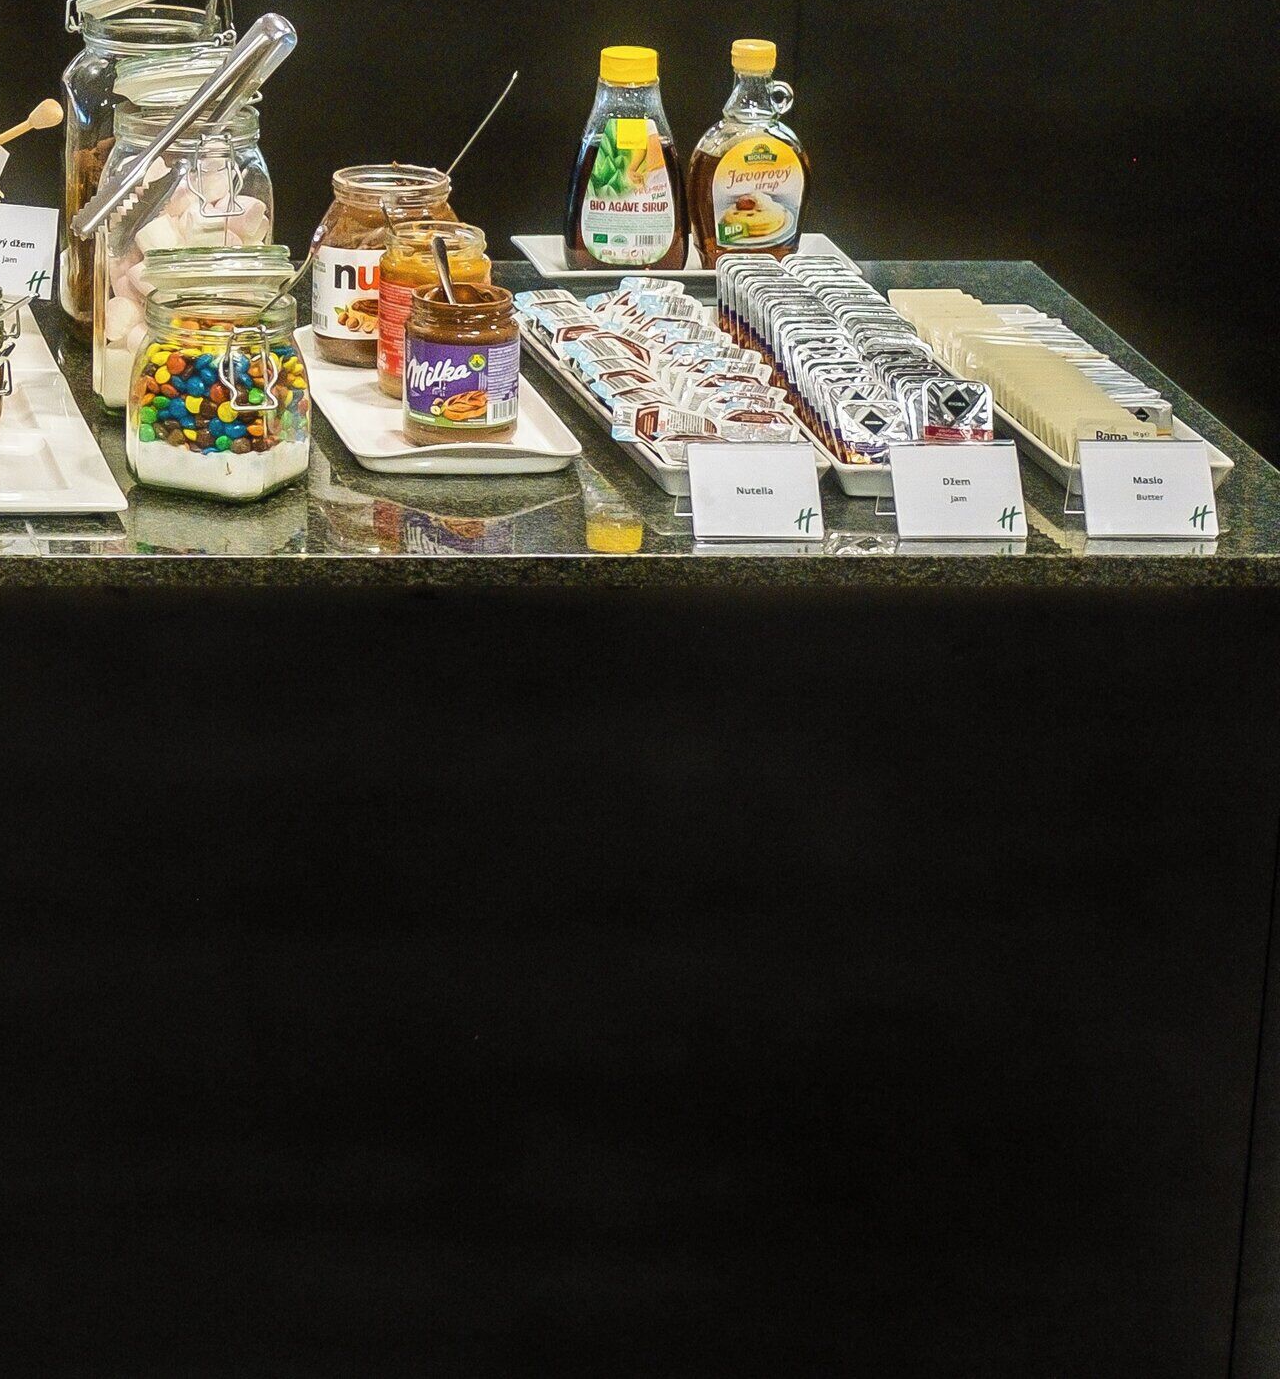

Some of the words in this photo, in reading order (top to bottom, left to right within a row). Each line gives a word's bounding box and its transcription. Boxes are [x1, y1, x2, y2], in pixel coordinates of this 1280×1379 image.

[726, 166, 791, 189] Javorový
[755, 181, 779, 192] sirup
[589, 200, 606, 211] BIO
[642, 201, 669, 212] SIRUP
[724, 224, 742, 235] BIO
[9, 238, 36, 249] džem
[1, 255, 18, 264] jam
[406, 356, 473, 391] Milka
[1096, 430, 1128, 441] Rama
[942, 477, 971, 486] Džem
[1132, 476, 1164, 485] Maslo
[736, 487, 774, 495] Nutella
